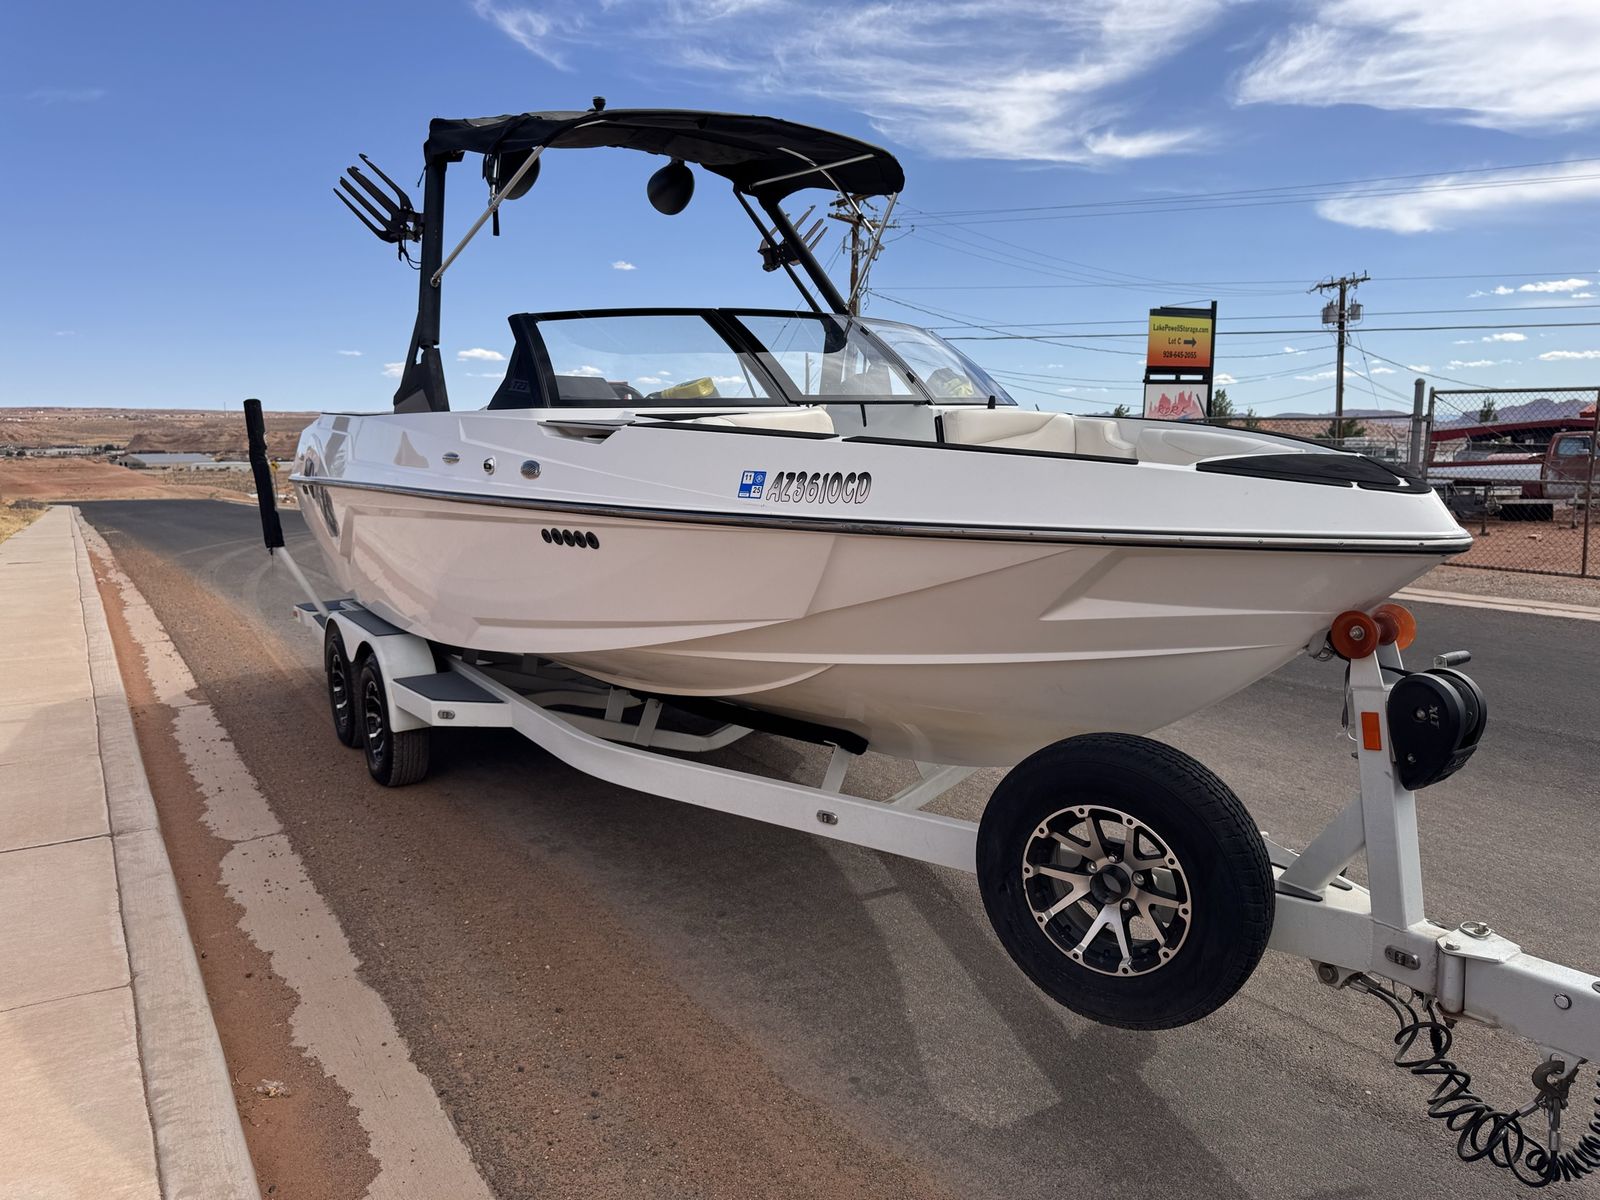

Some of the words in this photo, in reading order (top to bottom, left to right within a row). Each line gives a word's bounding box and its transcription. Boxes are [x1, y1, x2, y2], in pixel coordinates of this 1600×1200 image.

[1153, 323, 1209, 334] LakePowellStorage.com
[1168, 337, 1177, 345] Lot
[1177, 337, 1182, 345] C
[752, 486, 761, 494] 25
[766, 471, 872, 504] AZ3610CD
